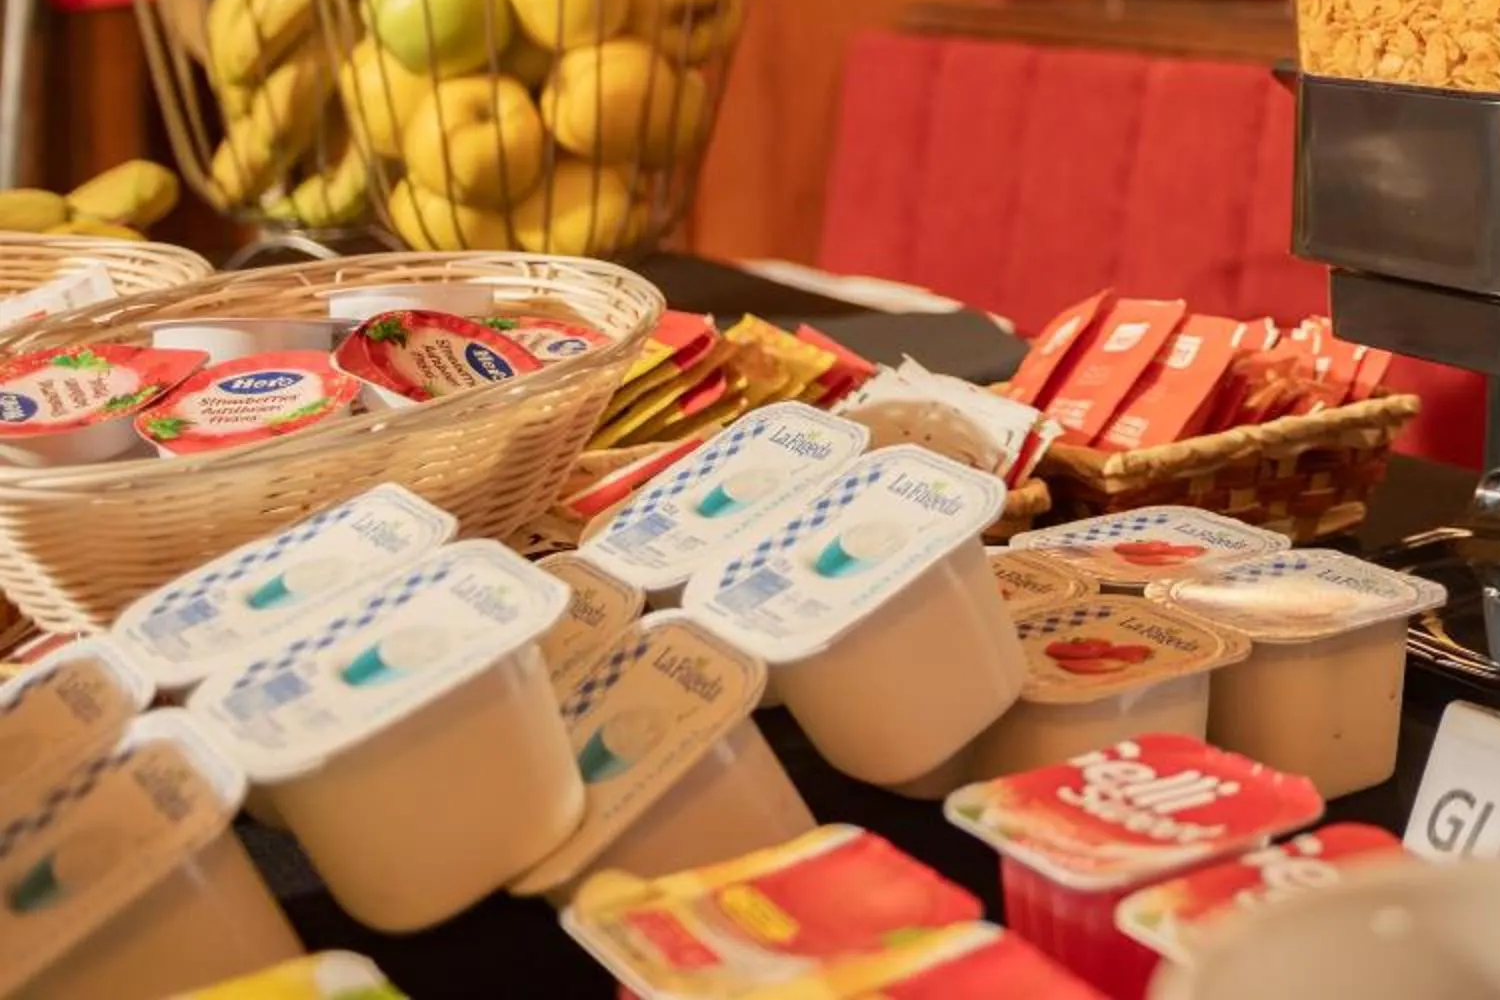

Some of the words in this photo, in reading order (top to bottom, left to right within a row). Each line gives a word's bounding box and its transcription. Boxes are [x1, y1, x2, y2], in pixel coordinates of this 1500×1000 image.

[231, 376, 295, 390] Hero
[1118, 615, 1146, 632] La
[1144, 621, 1200, 653] Fageda
[652, 646, 678, 674] La
[669, 656, 724, 705] Fageda
